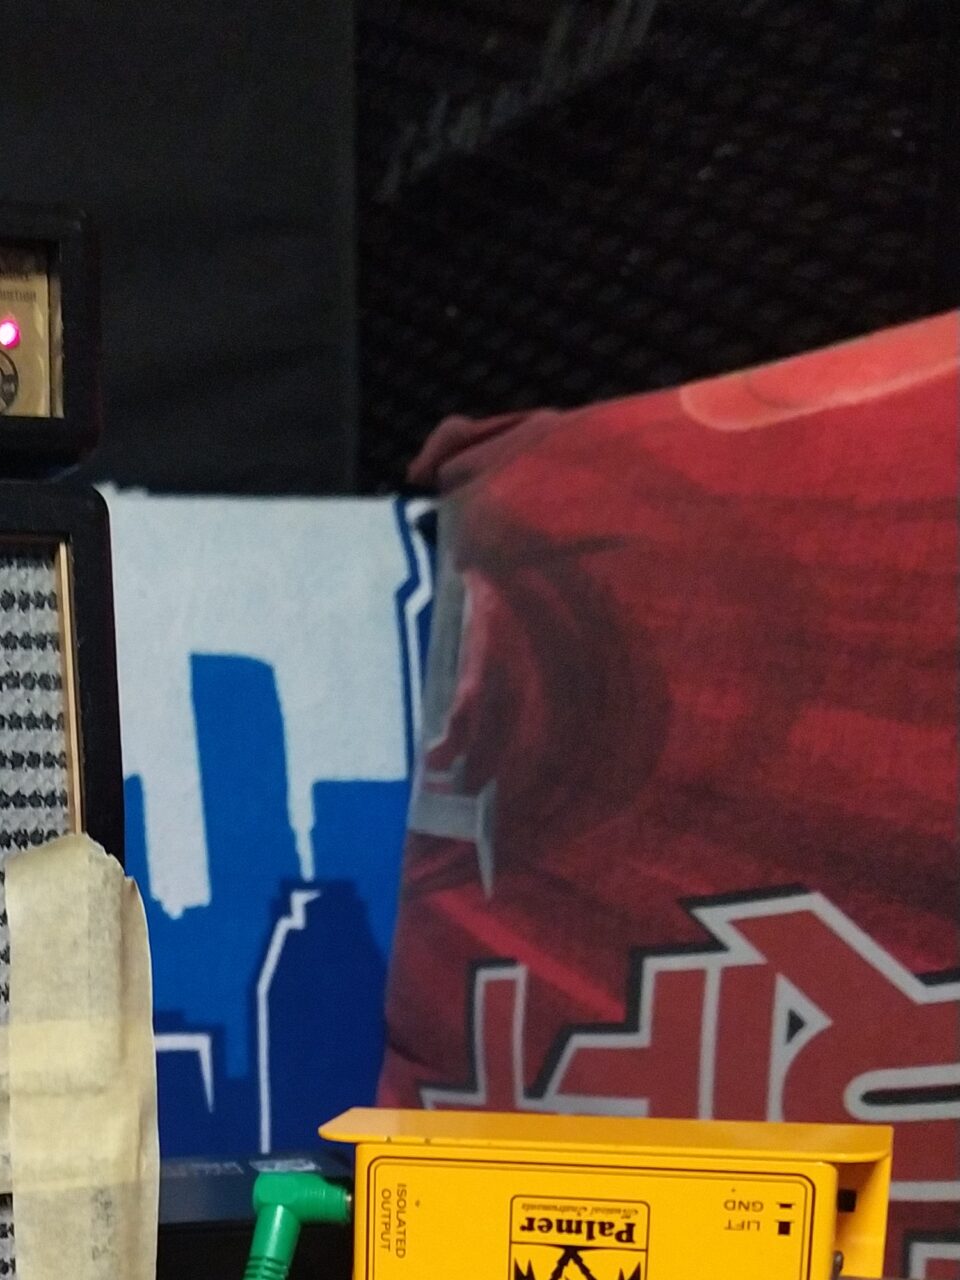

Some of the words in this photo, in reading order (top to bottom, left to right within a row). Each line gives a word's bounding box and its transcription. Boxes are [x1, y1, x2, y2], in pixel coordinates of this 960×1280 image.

[380, 1188, 392, 1252] OUTPUT
[722, 1199, 764, 1213] GND
[394, 1183, 407, 1260] ISOLATED
[520, 1216, 636, 1244] Palmer
[723, 1219, 760, 1232] LIFT
